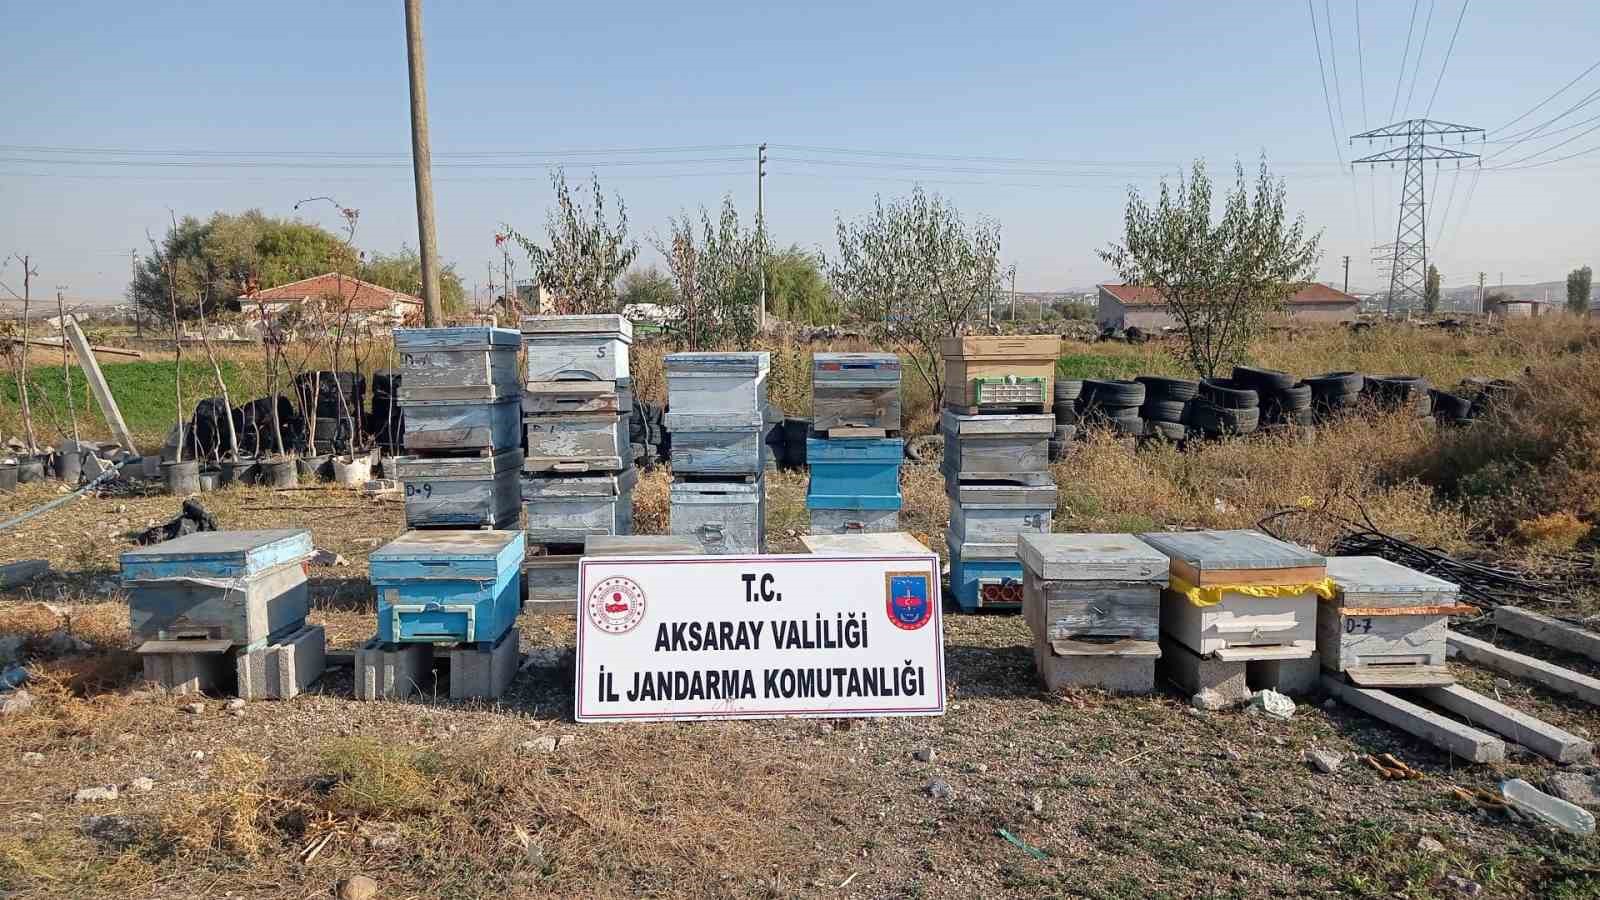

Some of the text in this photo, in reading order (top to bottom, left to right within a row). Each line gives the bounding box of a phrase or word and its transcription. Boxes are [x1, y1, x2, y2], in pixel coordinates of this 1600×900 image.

[741, 573, 782, 602] T.C.
[654, 620, 764, 652] AKSARAY
[771, 612, 868, 650] VALİLİĞİ
[598, 660, 925, 702] İL JANDARMA KOMUTANLIĞI
